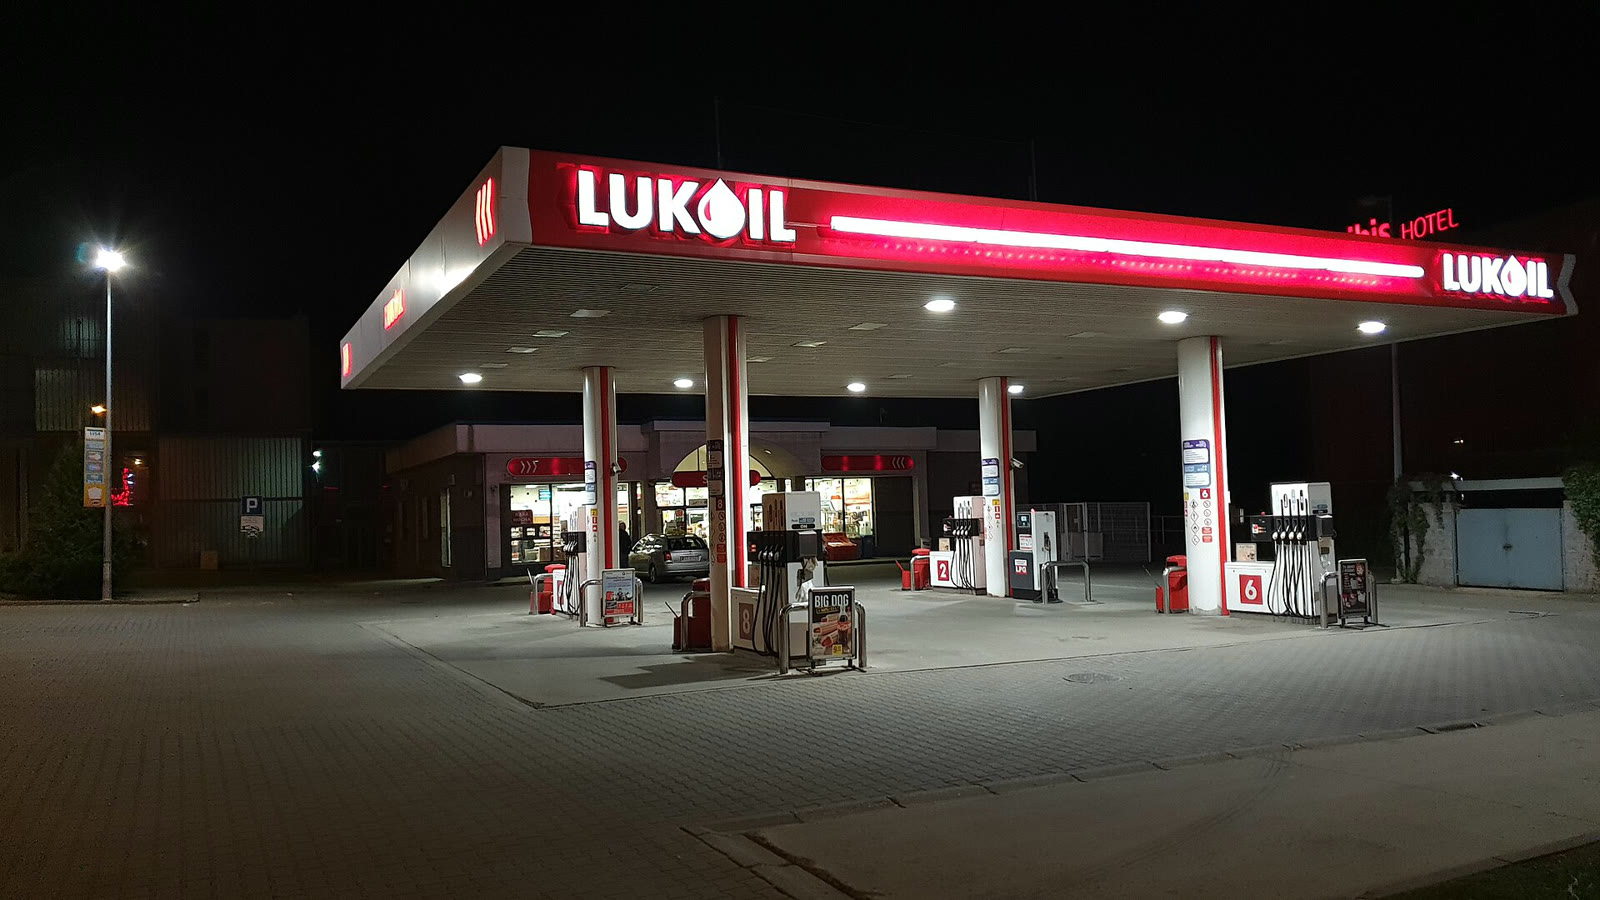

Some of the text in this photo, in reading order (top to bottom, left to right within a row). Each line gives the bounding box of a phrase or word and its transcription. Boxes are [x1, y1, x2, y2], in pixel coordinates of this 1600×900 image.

[577, 169, 797, 243] LUKOIL
[1401, 208, 1459, 240] HOTEL
[1443, 252, 1554, 298] LUKOIL
[1201, 489, 1209, 498] 6
[246, 497, 258, 513] P
[939, 562, 947, 578] 2
[1245, 579, 1257, 600] 6
[814, 594, 849, 608] BIG DOG
[742, 608, 751, 635] 8
